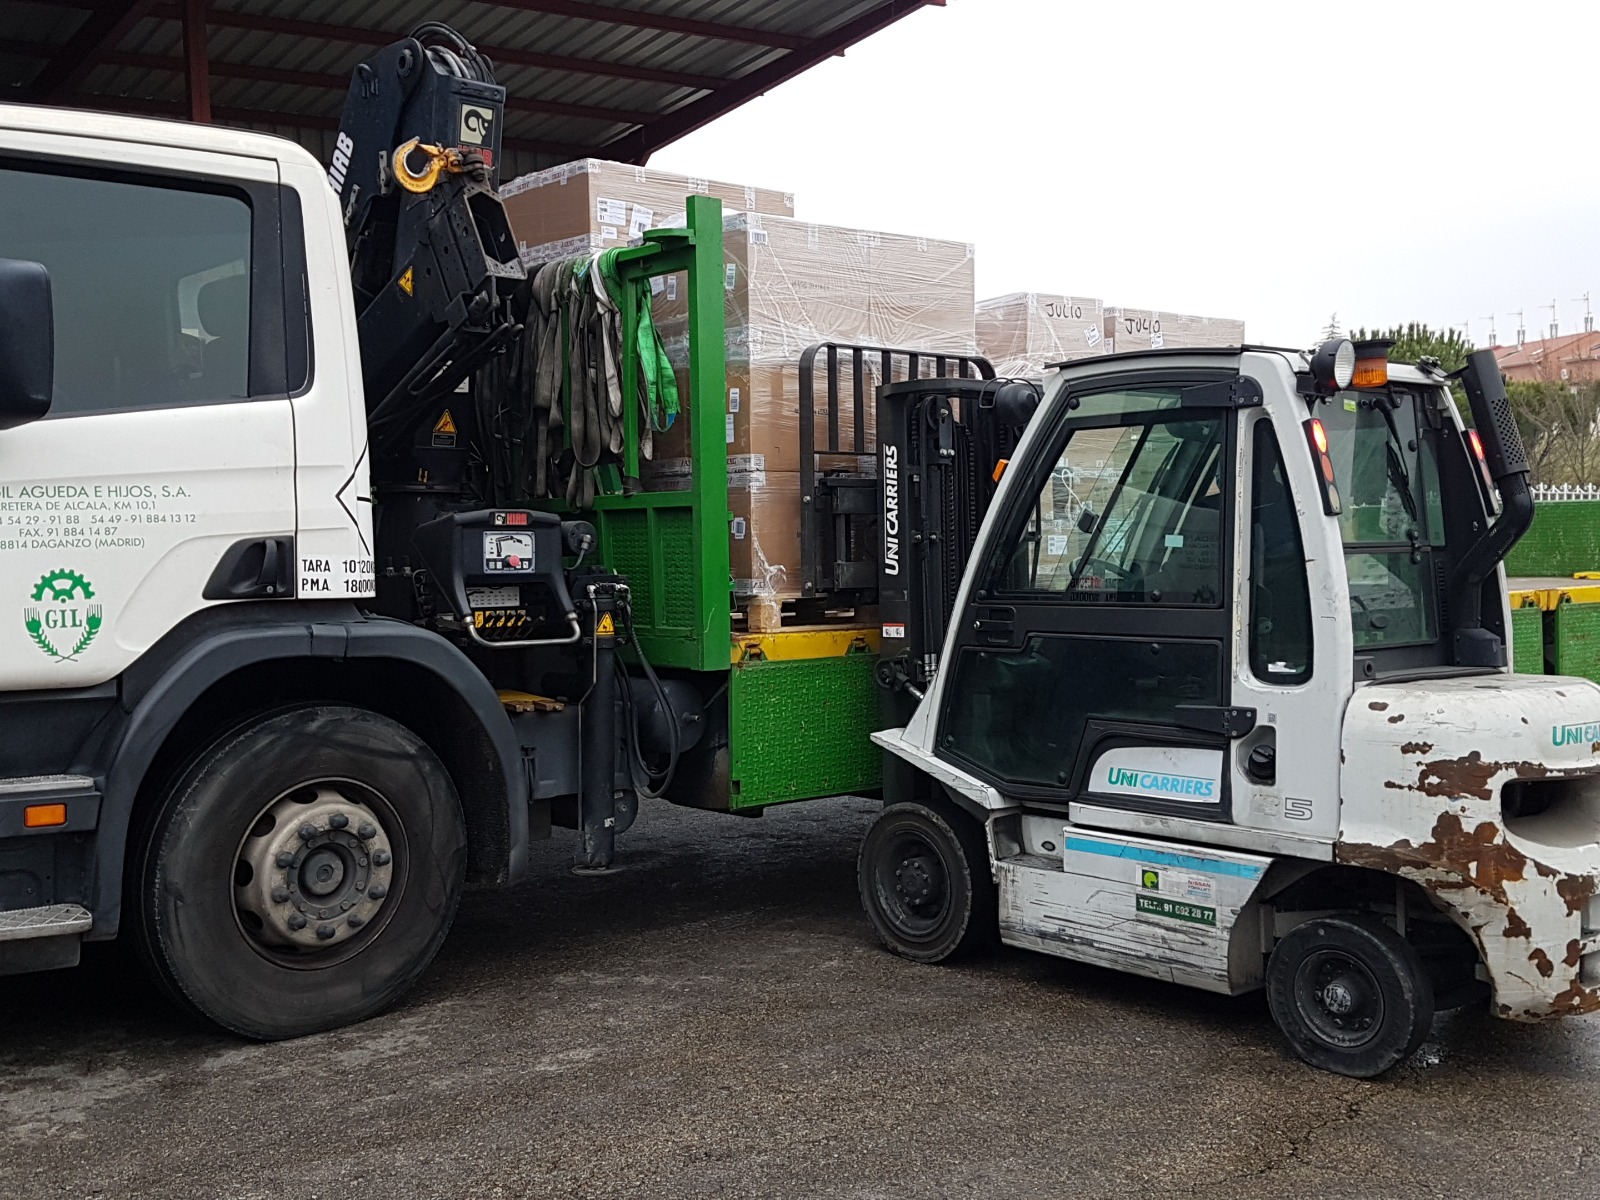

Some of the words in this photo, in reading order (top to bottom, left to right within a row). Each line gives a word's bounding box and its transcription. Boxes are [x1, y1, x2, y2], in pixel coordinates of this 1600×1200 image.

[1045, 303, 1082, 319] JULIO
[1124, 318, 1160, 334] JULIO
[0, 485, 13, 499] IL
[19, 485, 89, 499] AGUEDA
[94, 485, 103, 498] E
[107, 485, 157, 499] HIJOS,
[161, 485, 191, 498] S.A.
[0, 501, 43, 511] RETERA
[46, 501, 60, 511] DE
[64, 501, 111, 511] ALCALA,
[113, 501, 132, 510] KM
[136, 501, 156, 510] 10,1
[7, 515, 21, 525] 54
[25, 515, 39, 525] 29
[49, 515, 61, 525] 91
[65, 515, 80, 524] 88
[91, 515, 104, 524] 54
[108, 514, 121, 523] 49
[130, 514, 142, 523] 91
[146, 514, 166, 523] 884
[170, 514, 181, 523] 13
[185, 514, 196, 523] 12
[19, 528, 43, 537] FAX.
[47, 528, 59, 537] 91
[63, 527, 84, 537] 884
[89, 527, 100, 536] 14
[104, 527, 118, 536] 87
[31, 538, 91, 549] DAGANZO
[95, 537, 145, 549] (MADRID)
[301, 559, 331, 573] TARA
[45, 608, 83, 629] GIL
[1187, 879, 1211, 888] NISSAN
[1163, 903, 1173, 913] 91
[1203, 911, 1213, 921] 77
